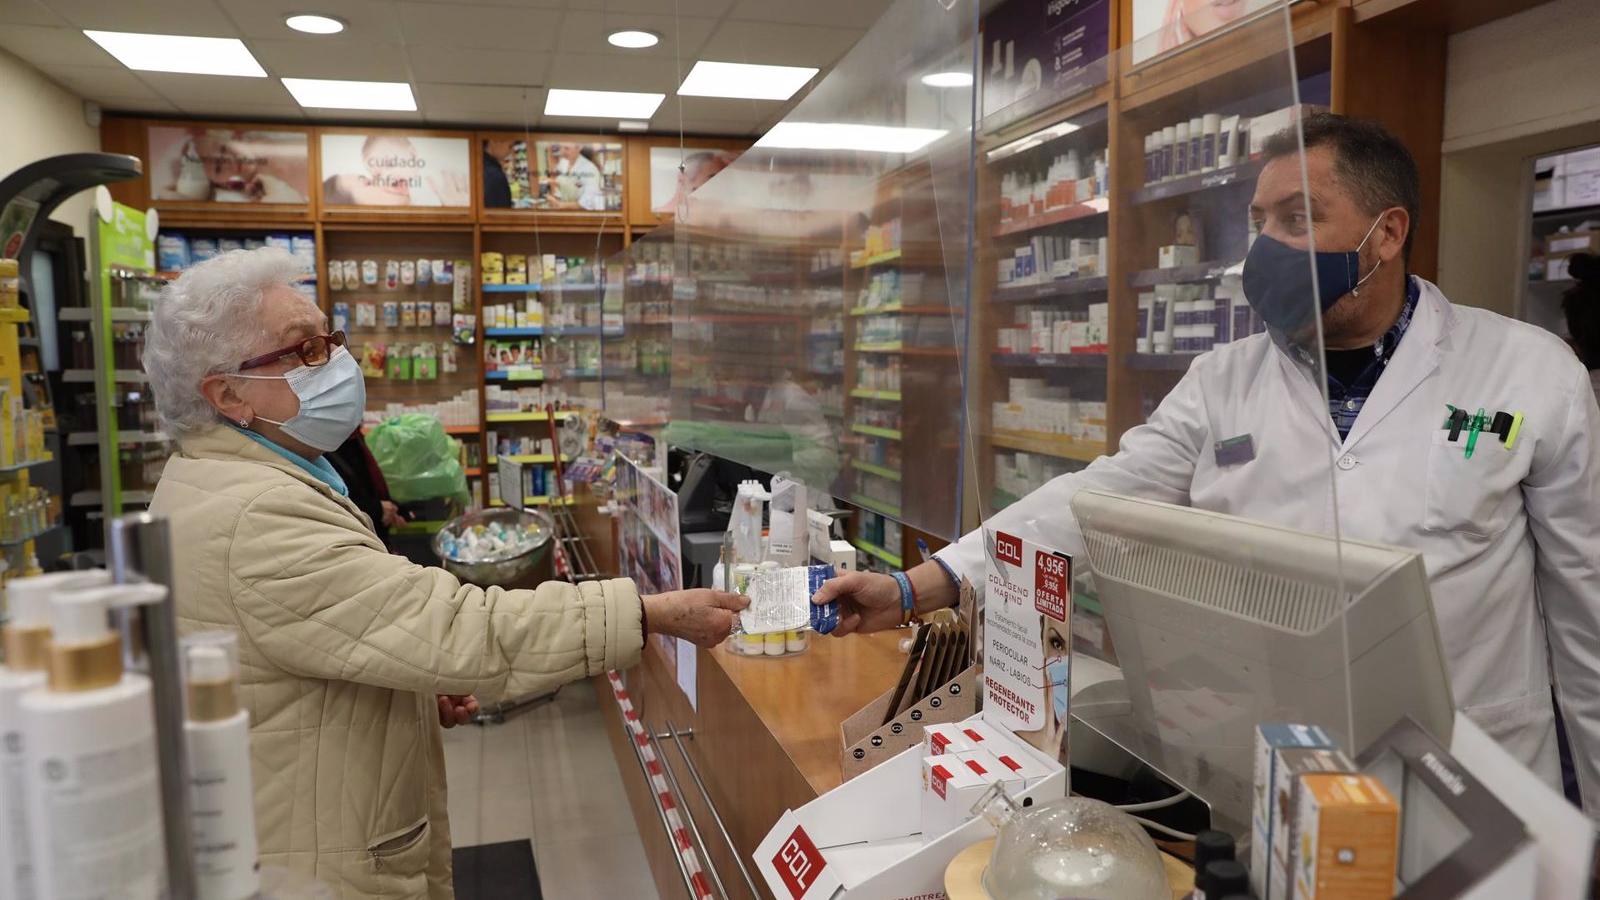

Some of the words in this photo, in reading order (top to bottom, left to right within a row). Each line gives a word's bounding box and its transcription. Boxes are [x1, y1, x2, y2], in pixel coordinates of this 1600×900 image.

[367, 155, 426, 168] cuidado
[997, 540, 1020, 561] COL
[1037, 554, 1065, 578] 4,95€
[989, 574, 1029, 598] COLAGENO
[994, 587, 1023, 606] MARINO
[1036, 588, 1065, 607] OFERTA
[1036, 597, 1065, 616] LIMITADA
[992, 640, 1029, 667] PERIOCULAR
[990, 655, 1006, 672] NARIZ
[1009, 666, 1032, 687] LABIOS
[985, 676, 1036, 715] REGENERANTE
[989, 691, 1030, 724] PROTECTOR
[932, 776, 945, 794] COL
[781, 838, 812, 890] COL
